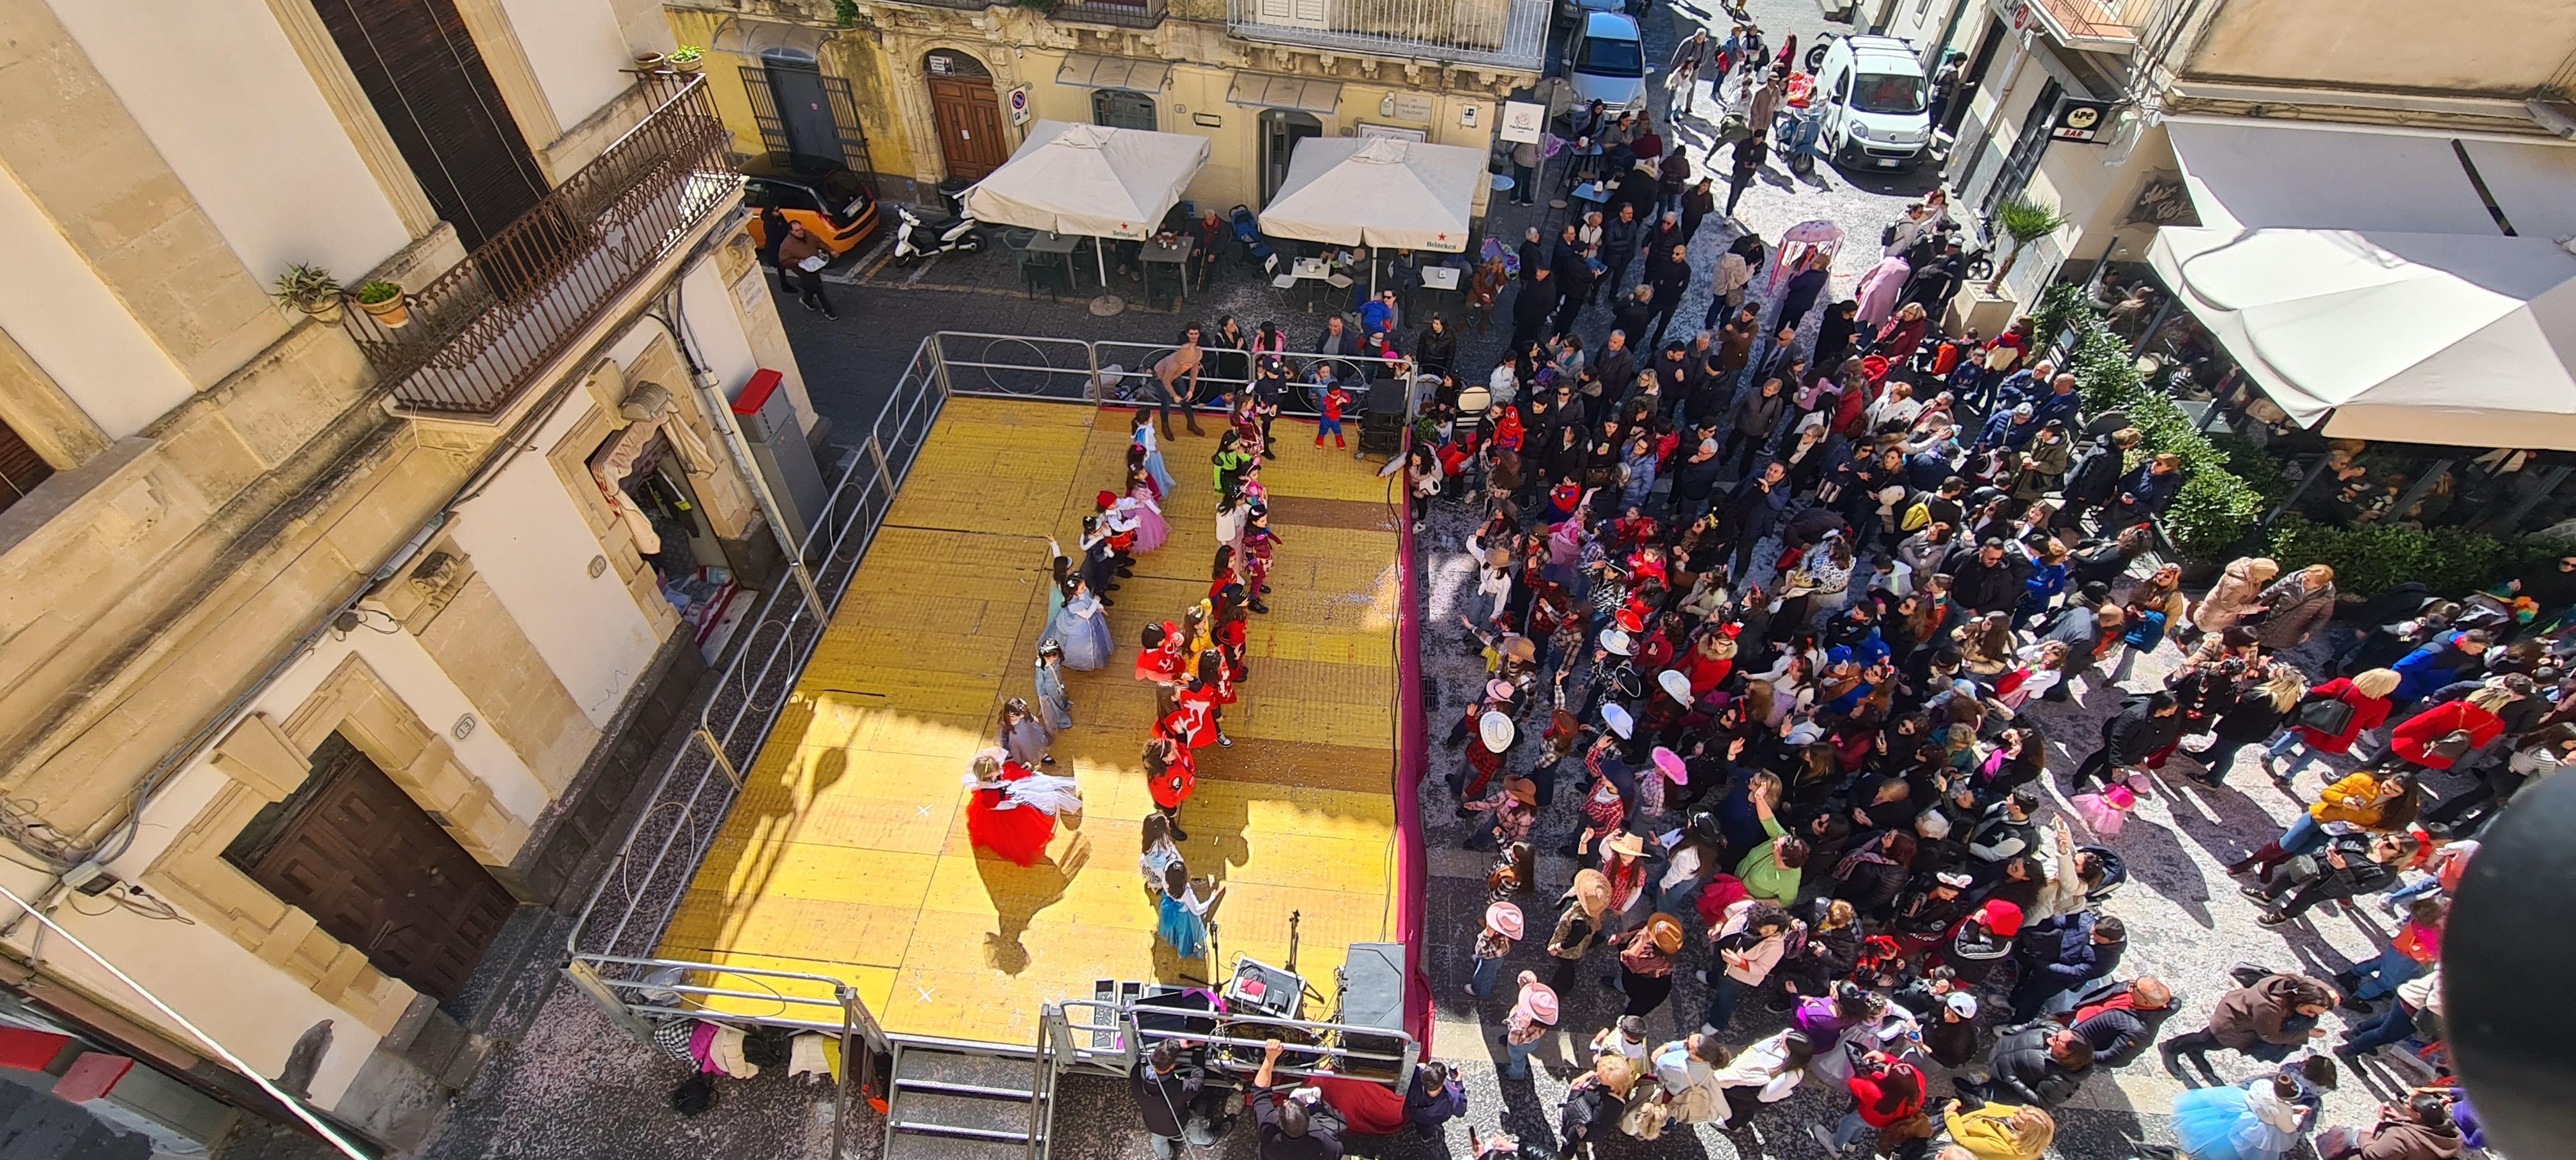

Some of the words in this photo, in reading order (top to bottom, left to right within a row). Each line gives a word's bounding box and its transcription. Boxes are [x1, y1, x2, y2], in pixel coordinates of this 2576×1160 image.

[2064, 129, 2084, 137] BAR
[1427, 241, 1457, 250] Heineken
[459, 721, 471, 735] 13
